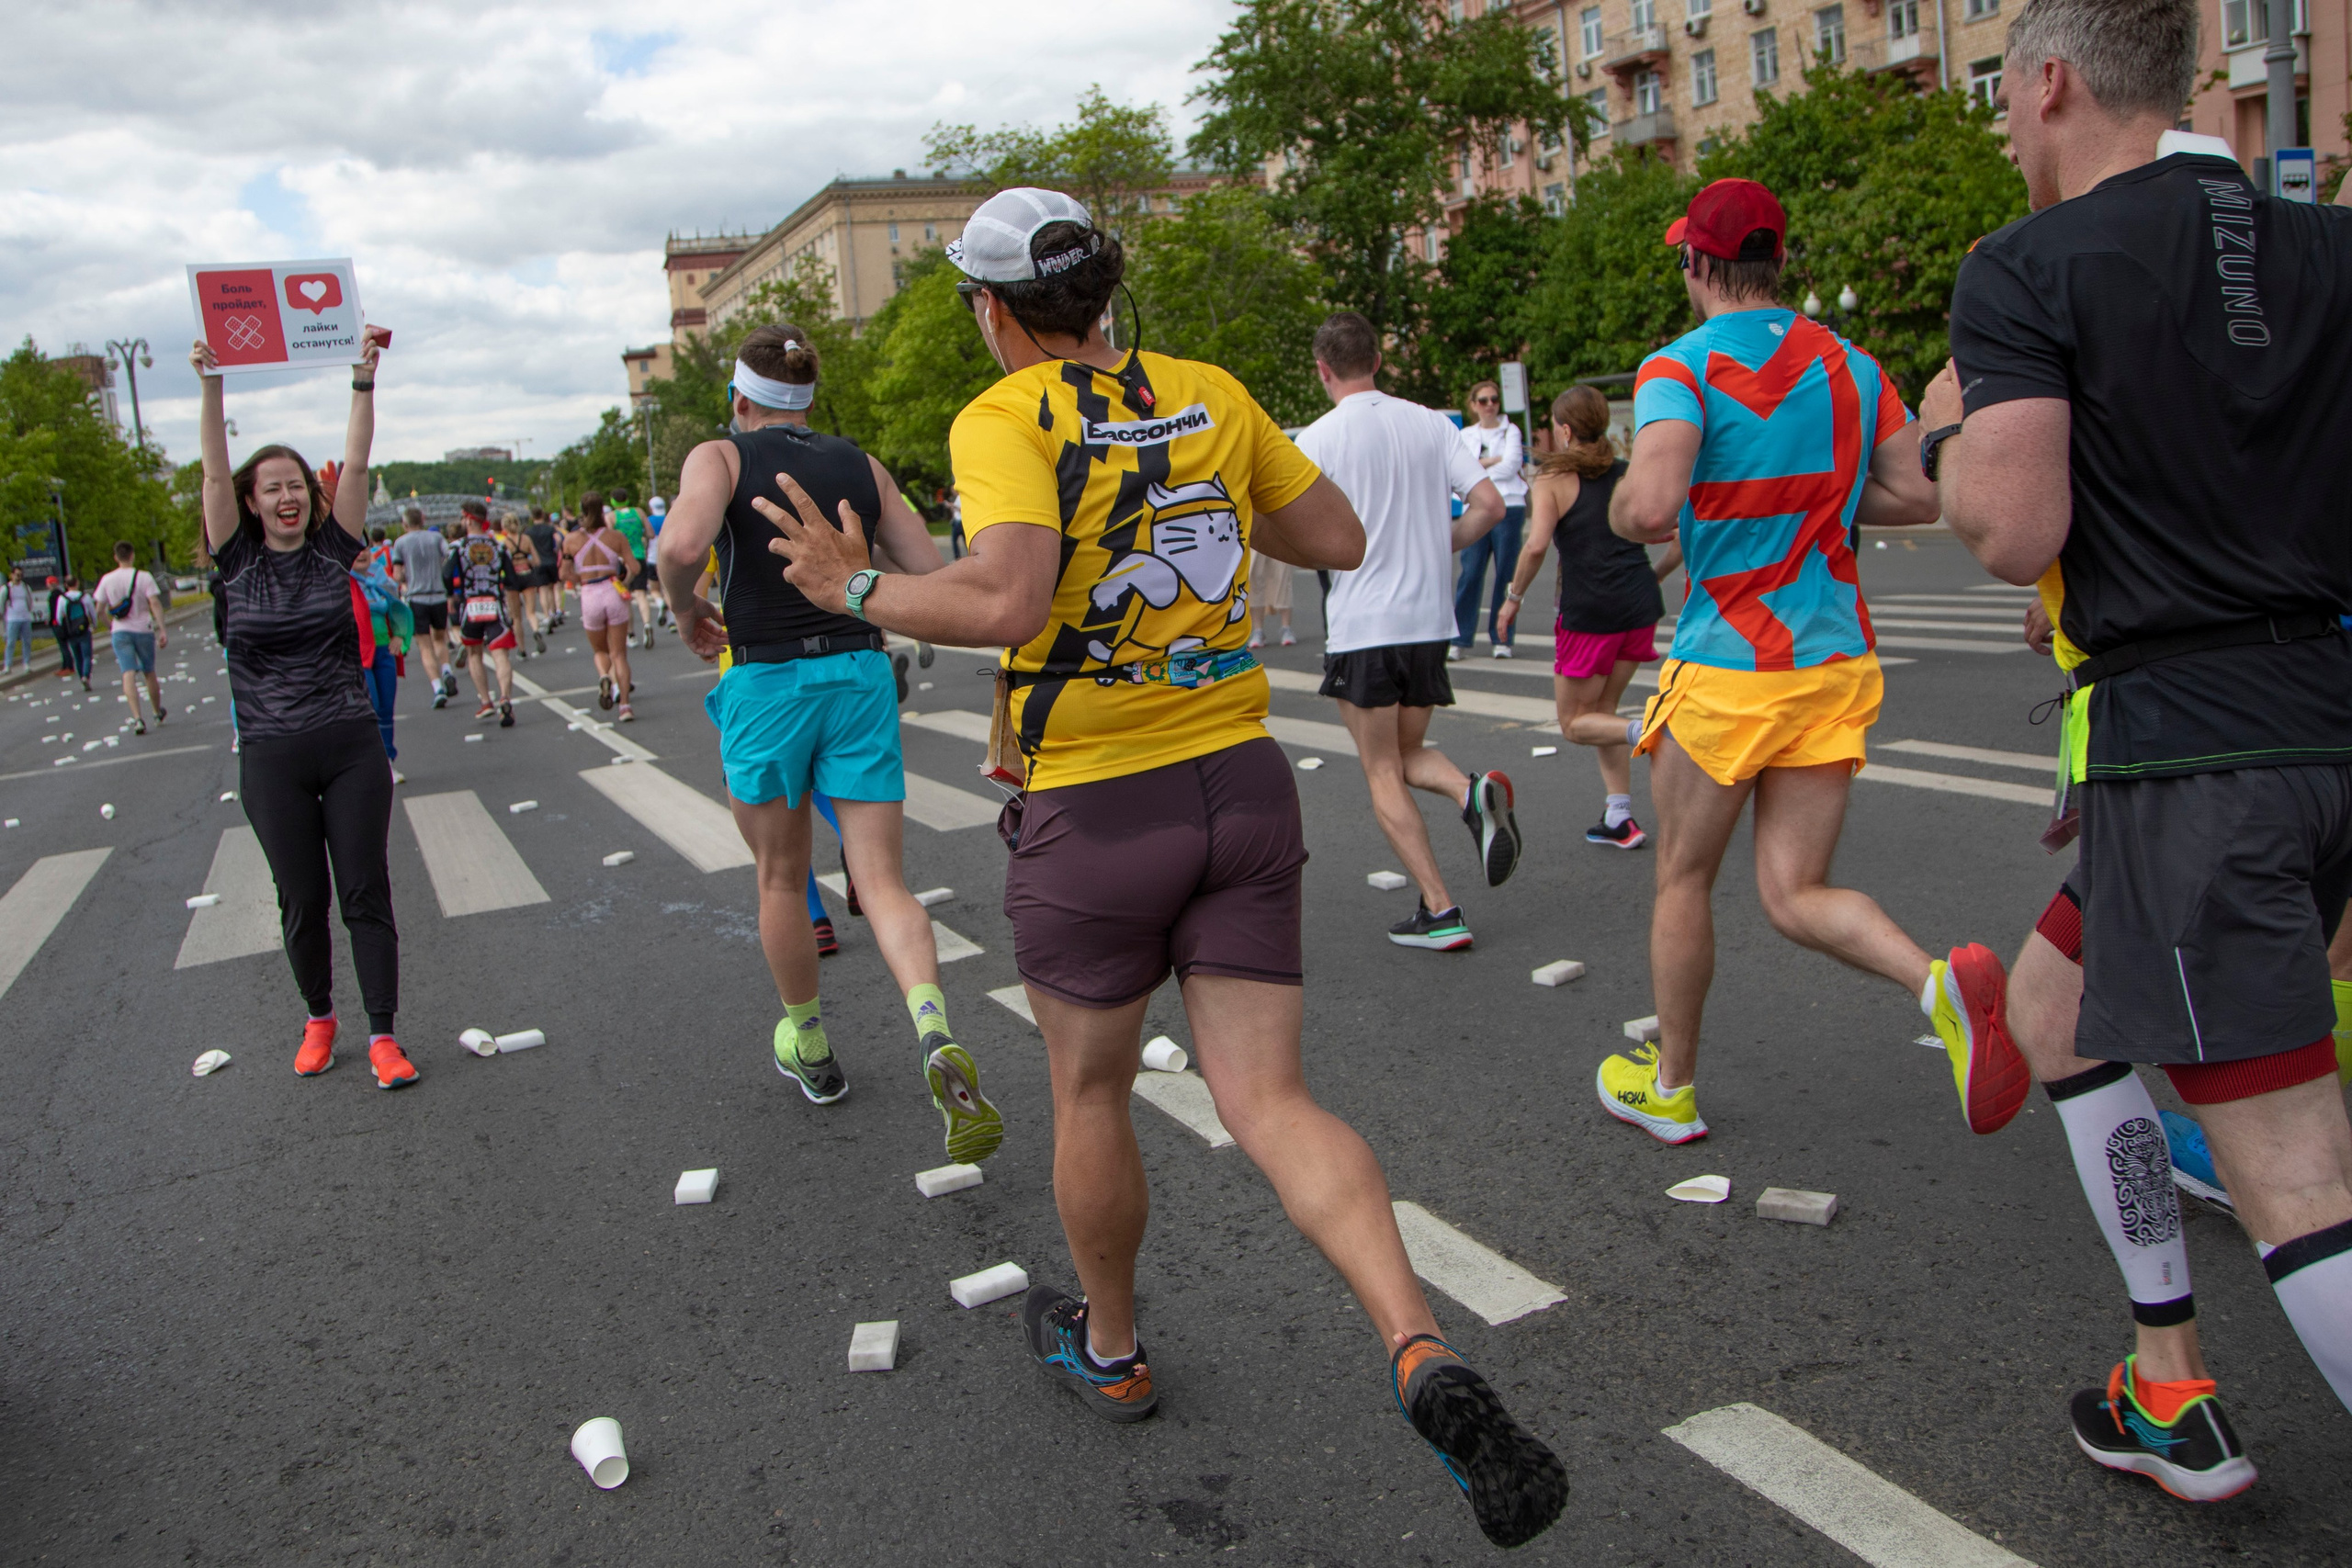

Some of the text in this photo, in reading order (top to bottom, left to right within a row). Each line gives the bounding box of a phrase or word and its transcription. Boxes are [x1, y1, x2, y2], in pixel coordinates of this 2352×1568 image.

[1036, 247, 1091, 277] WONDER
[2198, 178, 2271, 347] MIZUNO
[220, 283, 253, 294] Боль
[212, 299, 267, 311] пройдет,
[302, 322, 339, 333] лайки
[291, 334, 355, 350] останутся!
[1617, 1090, 1647, 1105] HOKA
